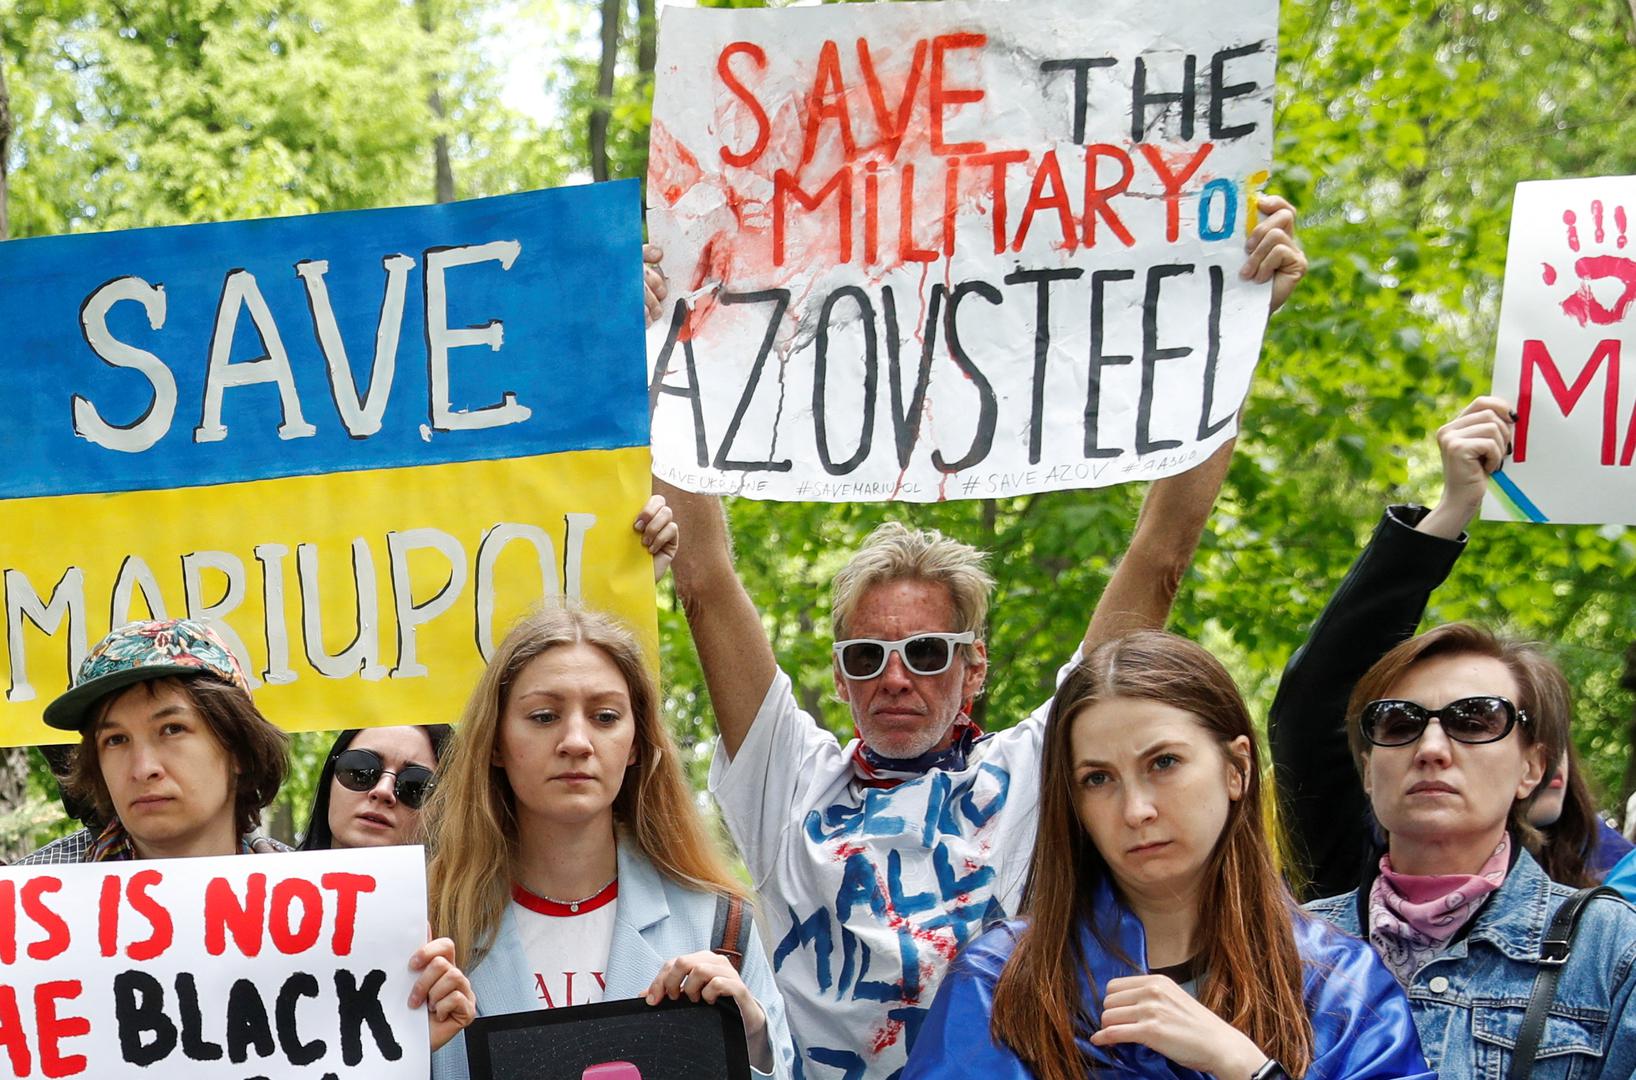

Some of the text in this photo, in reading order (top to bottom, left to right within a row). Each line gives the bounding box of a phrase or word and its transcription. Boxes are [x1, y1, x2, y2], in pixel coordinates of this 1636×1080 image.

[717, 32, 1272, 168] SAVE THE
[771, 143, 1213, 267] MILITARY
[72, 240, 532, 453] SAVE
[649, 264, 1236, 476] AZOVSTEEL
[99, 869, 174, 961] IS
[205, 872, 376, 957] NOT
[836, 842, 996, 924] ALL
[114, 968, 402, 1067] BLACK
